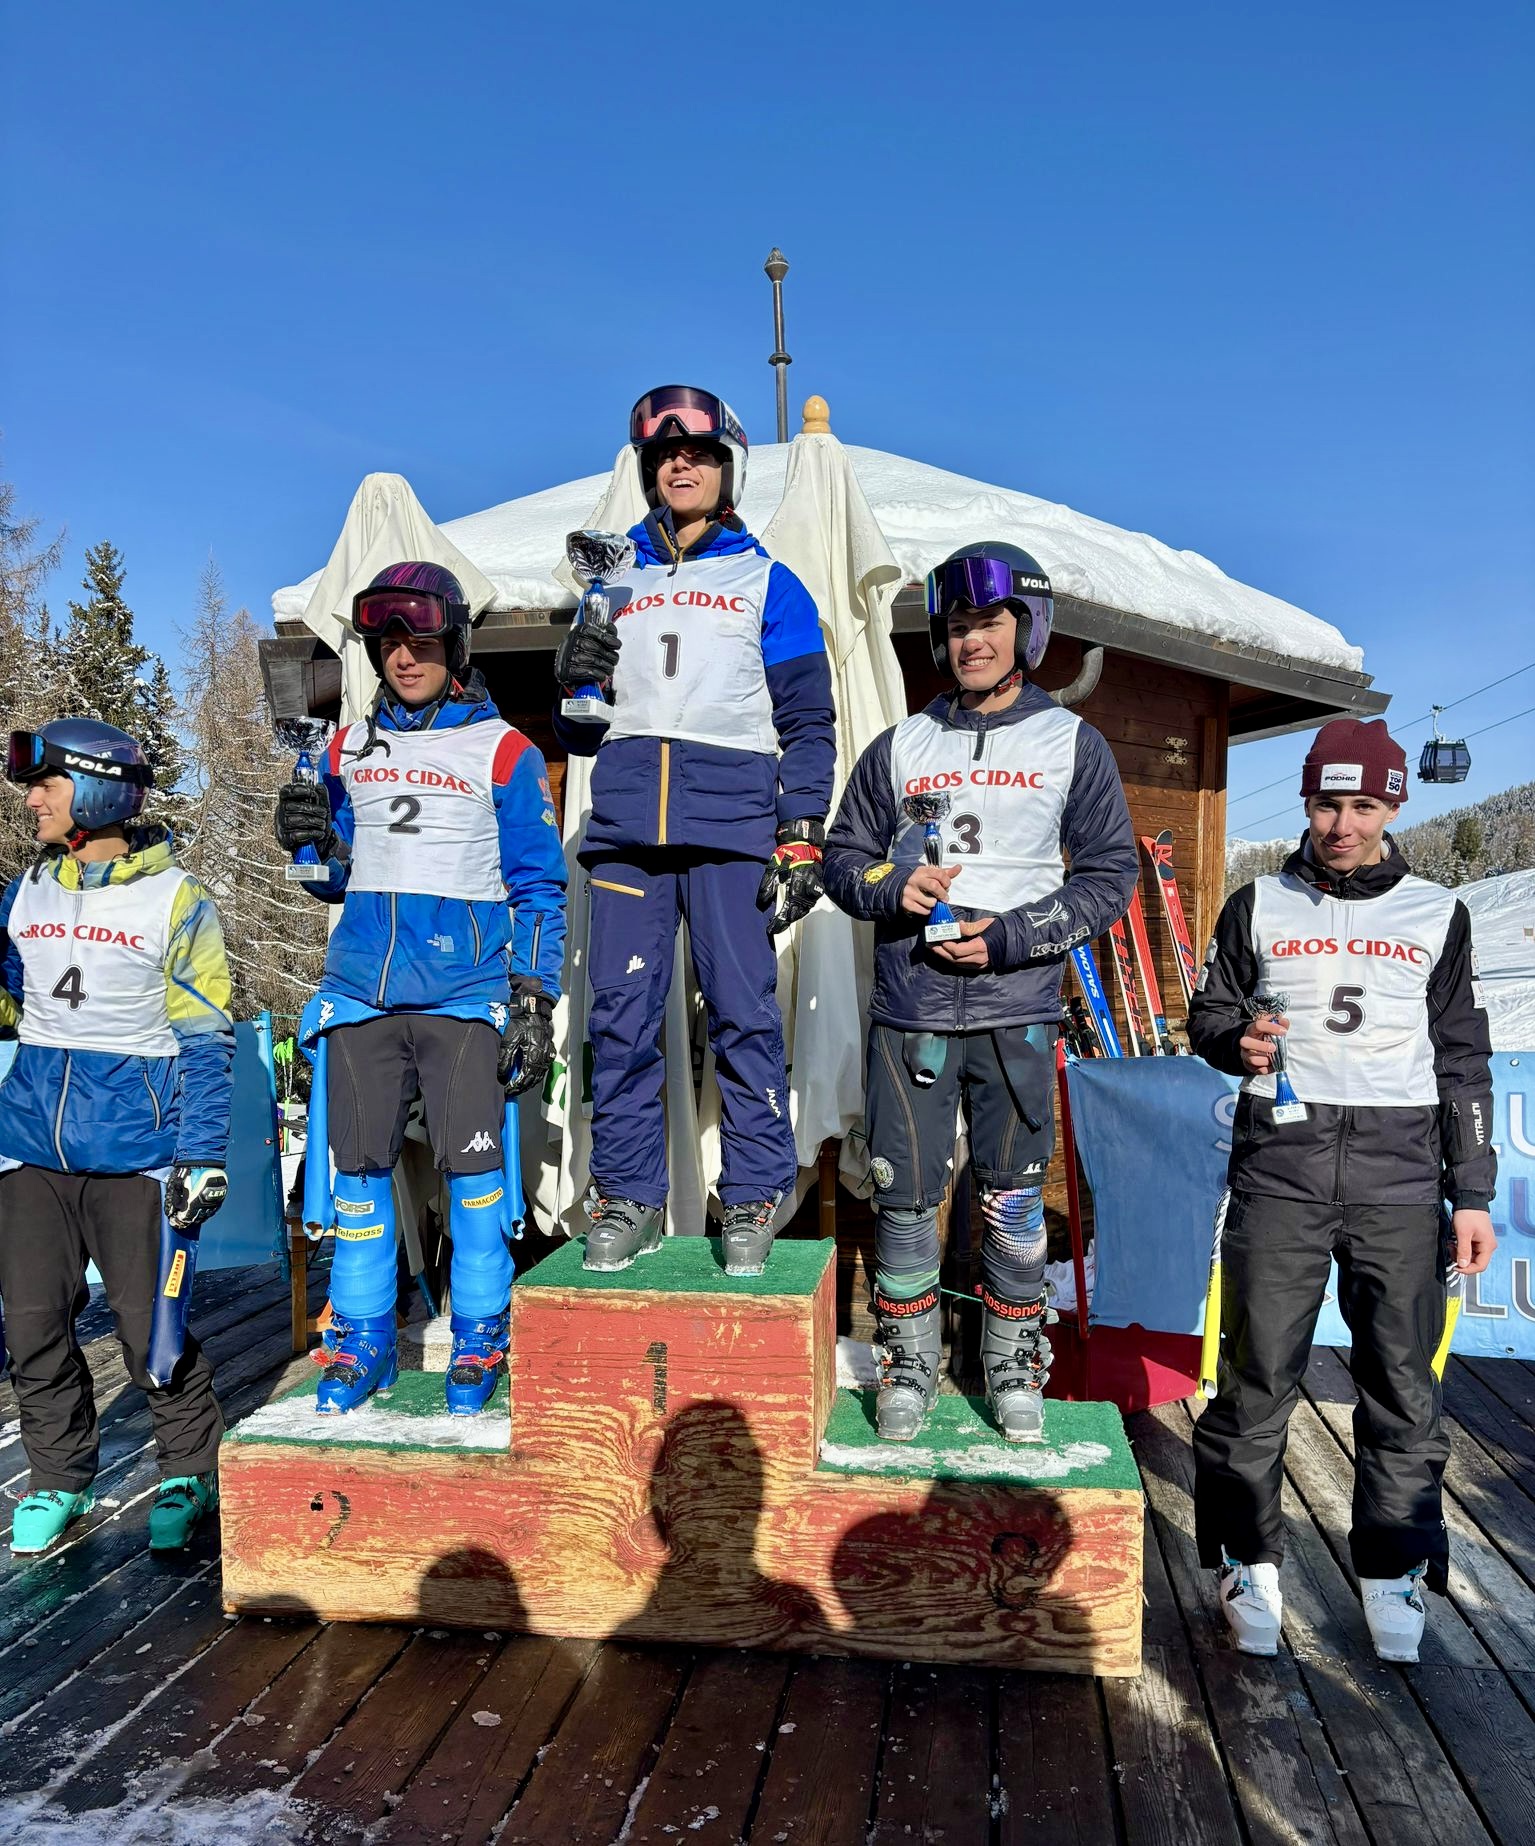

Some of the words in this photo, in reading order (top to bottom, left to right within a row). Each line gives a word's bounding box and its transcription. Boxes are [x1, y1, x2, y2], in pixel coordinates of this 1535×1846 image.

[1021, 577, 1050, 590] VOLA
[673, 591, 746, 612] CIDAC
[659, 632, 680, 679] 1
[65, 754, 122, 776] VOLA
[354, 768, 399, 783] GROS
[406, 769, 473, 794] CIDAC
[905, 771, 962, 794] GROS
[970, 770, 1044, 789] CIDAC
[1388, 782, 1400, 792] 50
[389, 796, 421, 833] 2
[948, 812, 982, 854] 3
[19, 923, 66, 938] GROS
[73, 925, 145, 950] CIDAC
[1272, 938, 1338, 956] GROS
[1347, 939, 1423, 964] CIDAC
[1077, 946, 1100, 999] SALOM
[49, 964, 89, 1011] 4
[1323, 984, 1366, 1036] 5
[1471, 1102, 1485, 1145] VITALINI
[336, 1199, 373, 1213] FORST
[337, 1227, 382, 1239] Telepass
[878, 1293, 938, 1314] ROSSIGNOL
[984, 1291, 1043, 1317] ROSSIGNOL
[642, 1341, 668, 1415] 1
